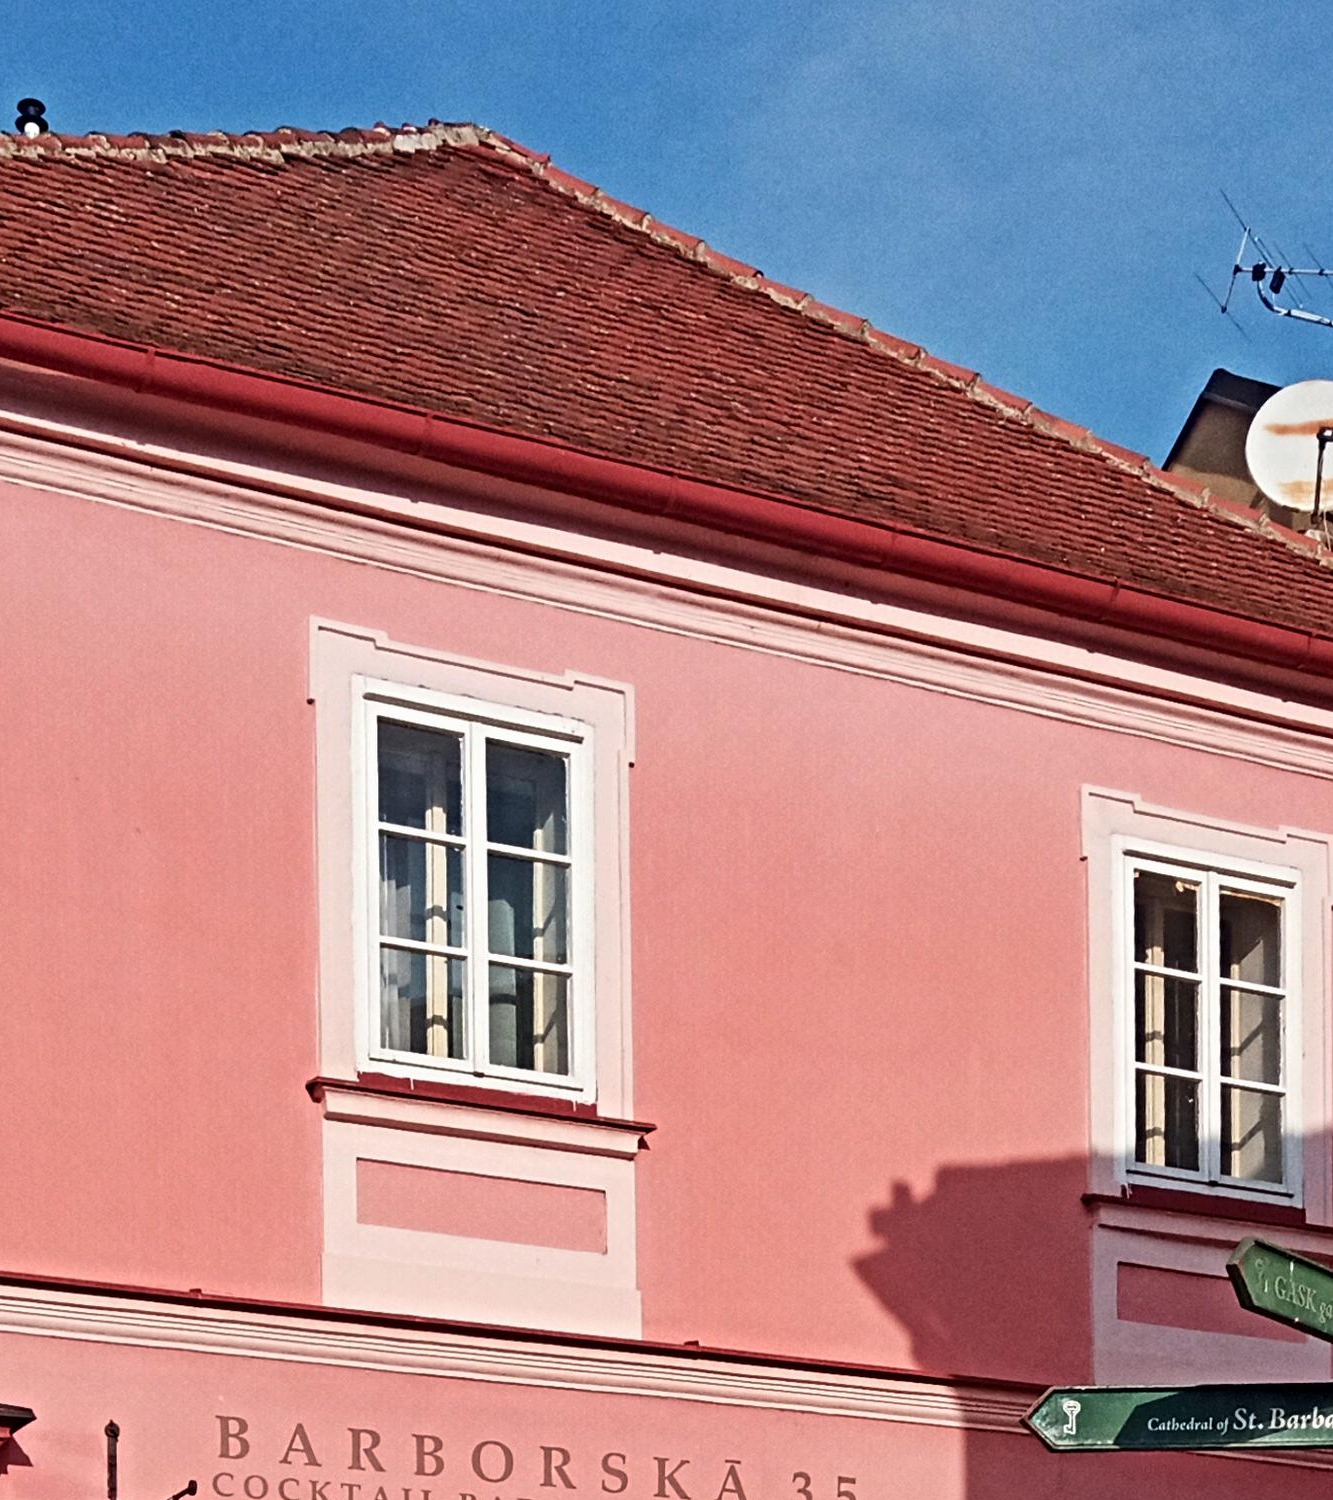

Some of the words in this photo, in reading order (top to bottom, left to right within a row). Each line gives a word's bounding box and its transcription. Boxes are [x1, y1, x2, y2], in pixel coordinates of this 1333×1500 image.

[1274, 1275, 1317, 1313] GASK
[1147, 1417, 1213, 1431] Cathedral
[1216, 1418, 1229, 1436] of
[1233, 1408, 1264, 1430] St.
